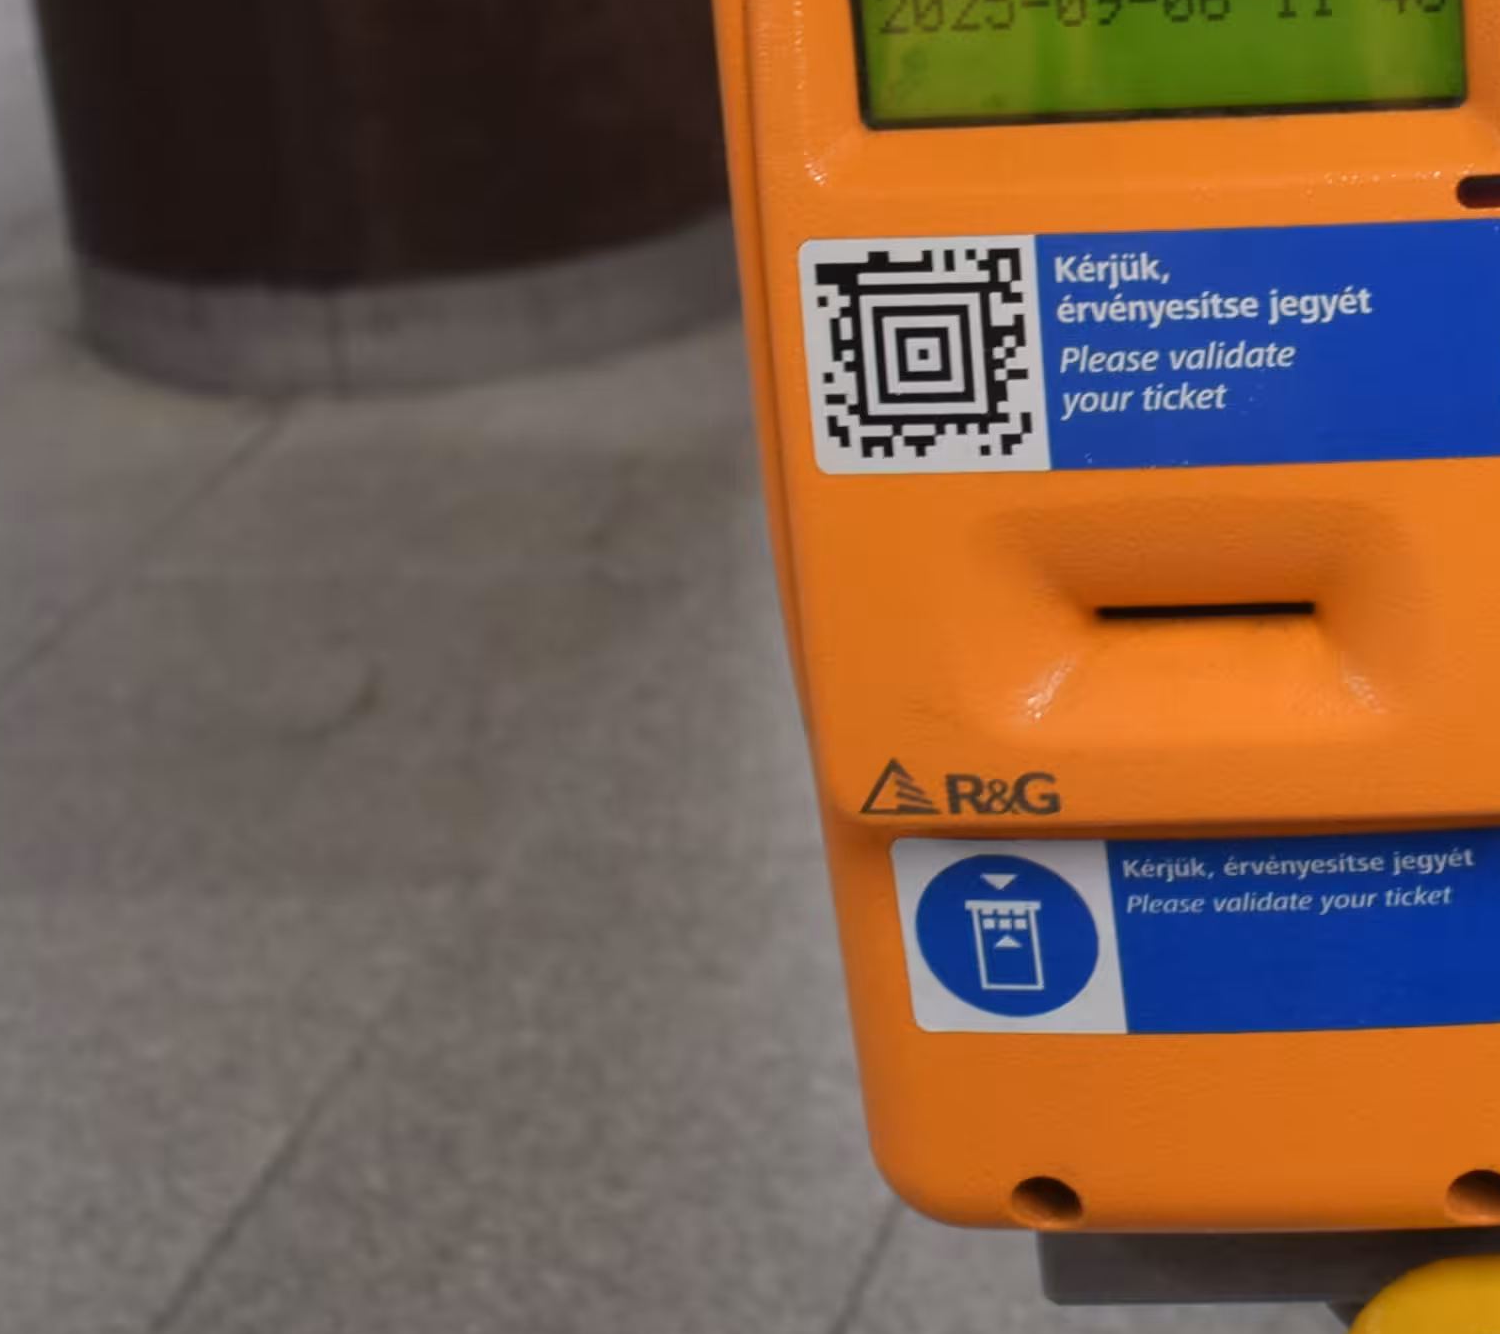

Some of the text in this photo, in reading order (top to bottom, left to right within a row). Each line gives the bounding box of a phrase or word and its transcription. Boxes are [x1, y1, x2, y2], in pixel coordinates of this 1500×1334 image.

[1053, 251, 1170, 289] Kérjük,
[1056, 285, 1373, 329] érvényesítse jegyét
[1060, 340, 1296, 374] Please validate
[1061, 382, 1228, 421] your ticket
[944, 771, 1062, 815] R&G
[1122, 847, 1475, 882] Kérjük, érvényesítse jegyét
[1126, 886, 1453, 916] Please validate your ticket
